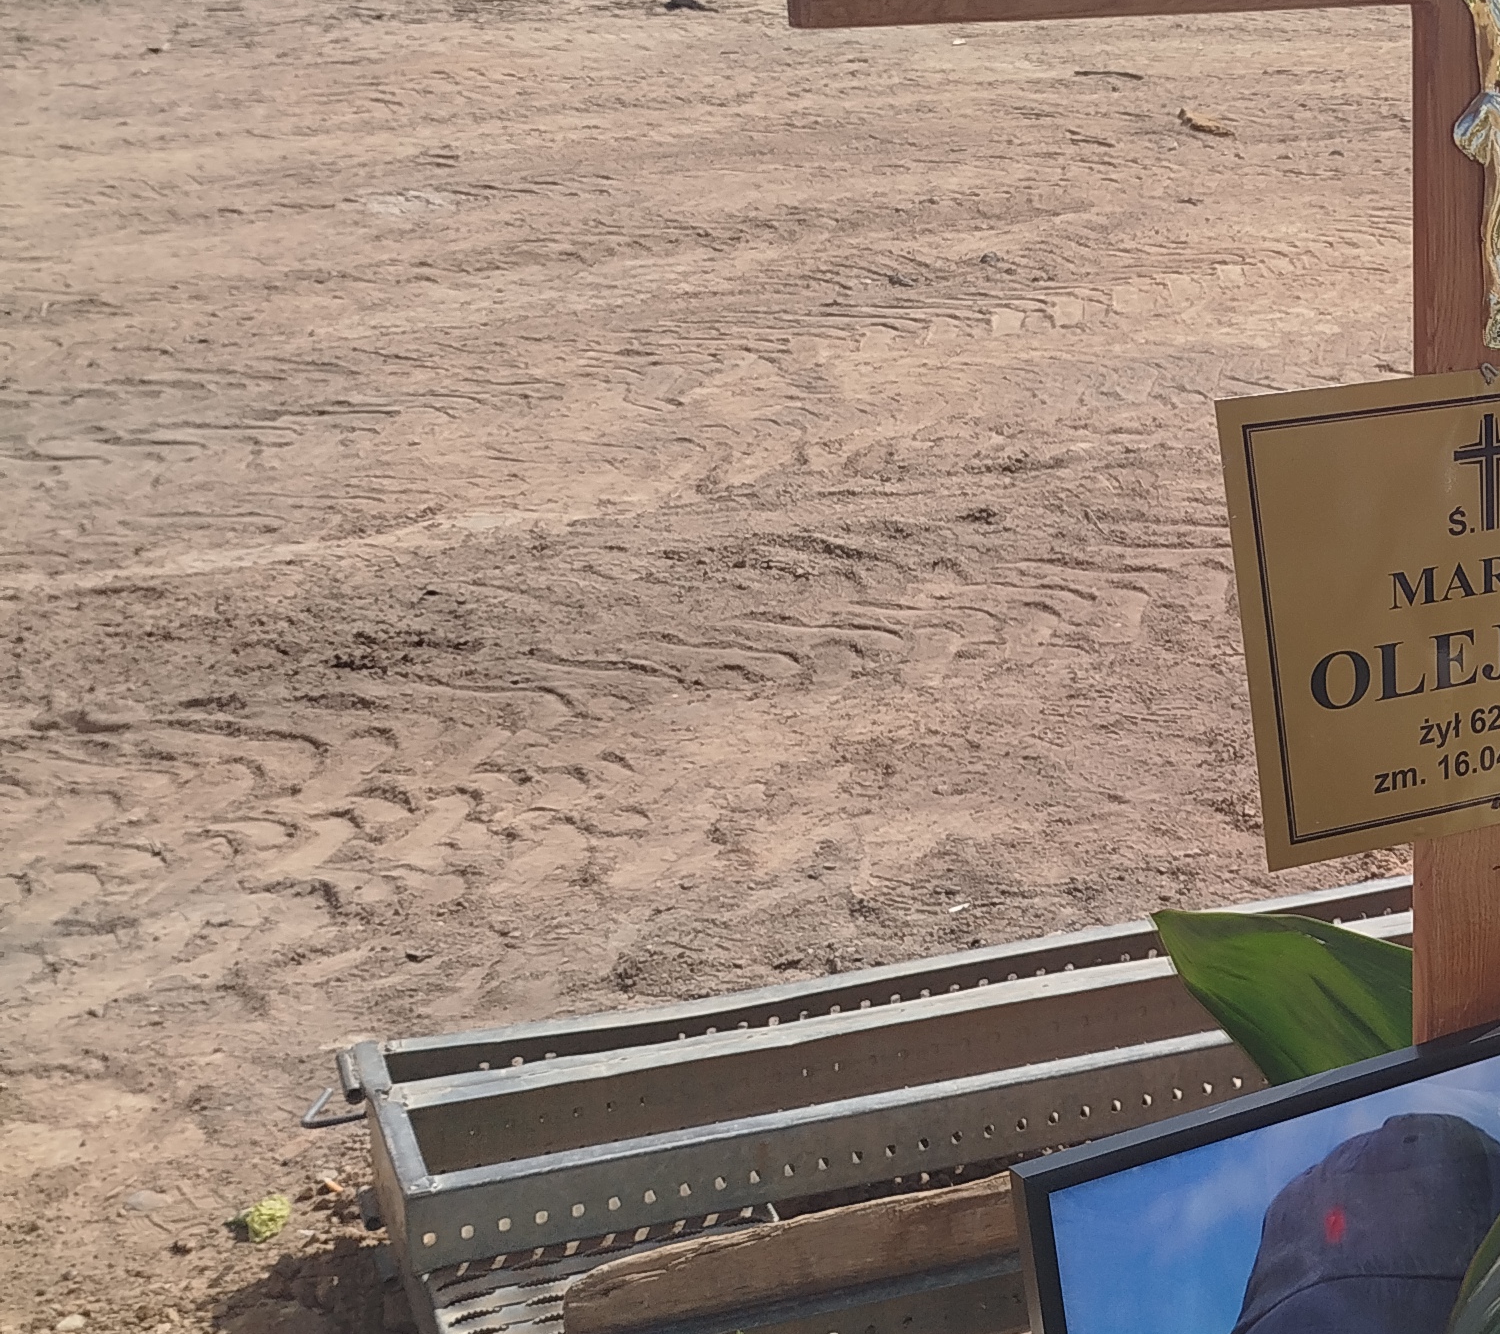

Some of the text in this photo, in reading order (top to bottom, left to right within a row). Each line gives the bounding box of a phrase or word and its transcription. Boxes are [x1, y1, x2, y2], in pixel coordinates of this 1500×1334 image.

[1447, 505, 1476, 537] Ś.
[1418, 712, 1463, 749] żył
[1373, 767, 1427, 795] zm.
